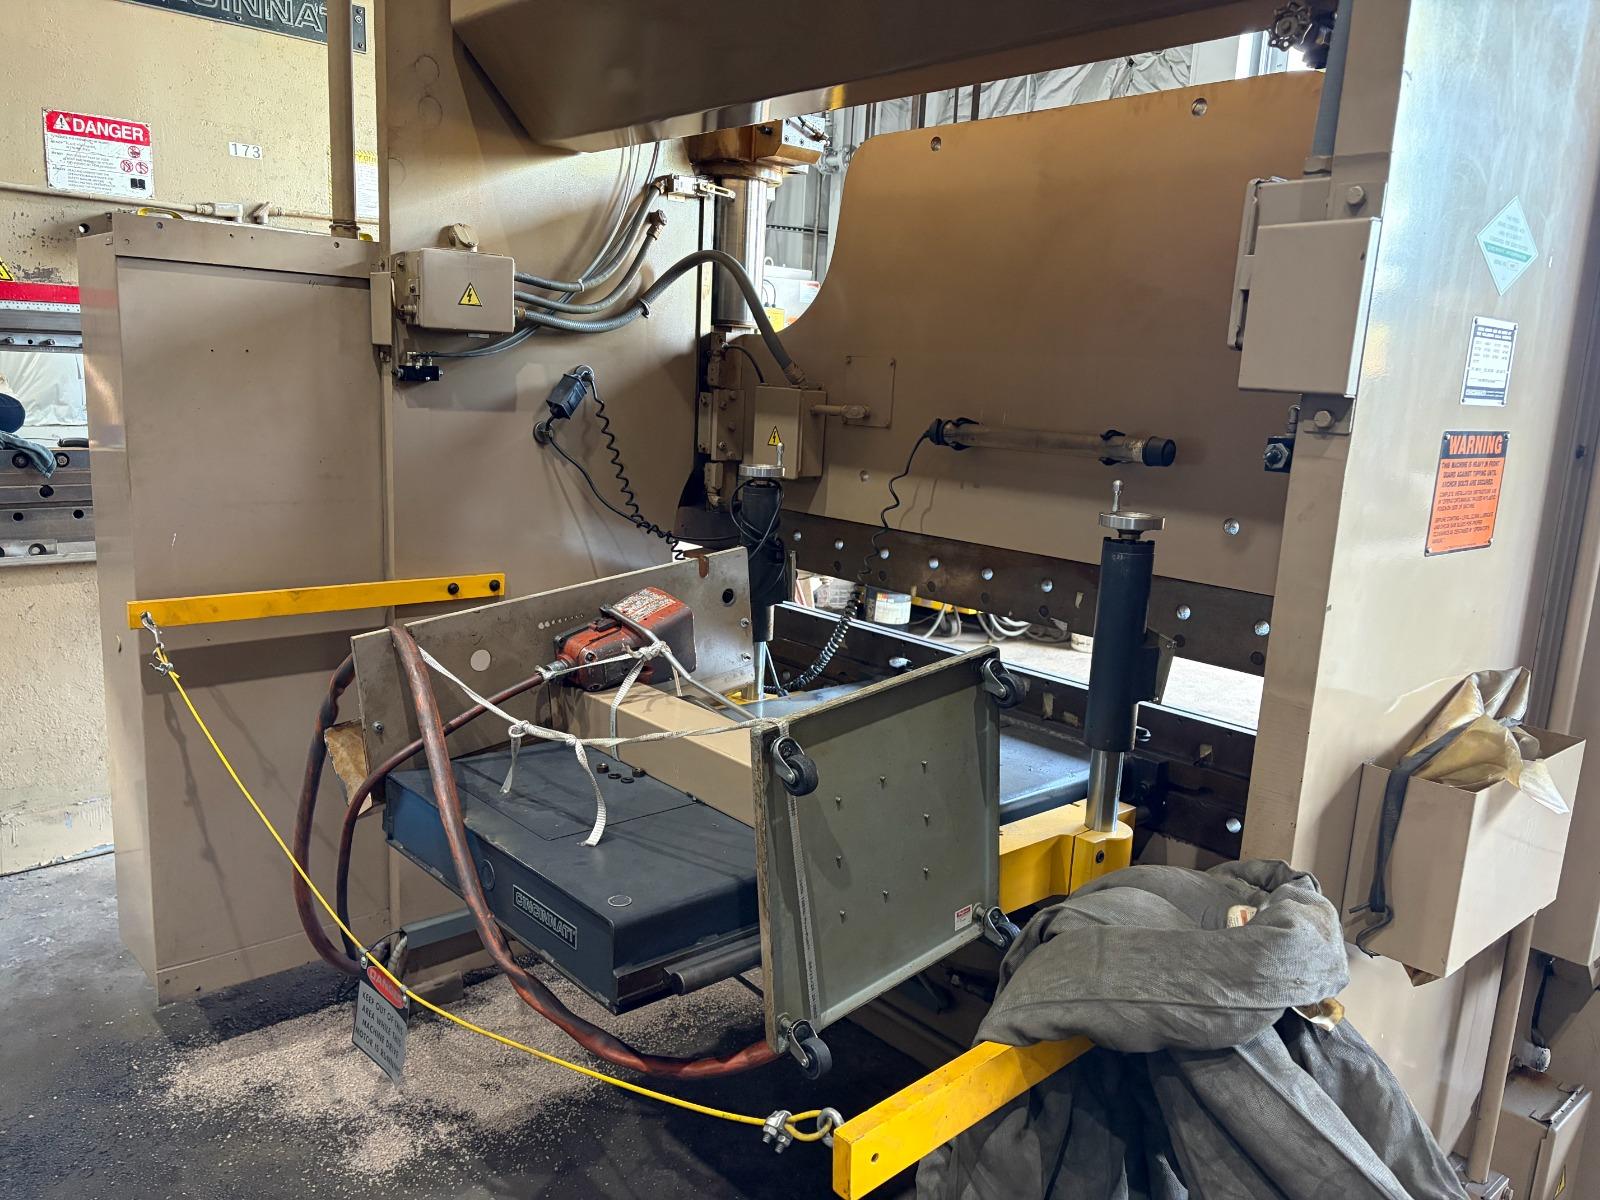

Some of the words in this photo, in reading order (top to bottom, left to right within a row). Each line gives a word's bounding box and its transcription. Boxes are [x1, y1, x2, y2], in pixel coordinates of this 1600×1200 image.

[72, 118, 145, 141] DANGER
[231, 143, 261, 159] 173
[1449, 435, 1503, 454] WARNING
[515, 891, 574, 942] CINCINNATI
[361, 1005, 375, 1021] AREA
[362, 991, 374, 1004] KEEP
[375, 1002, 386, 1015] OUT
[387, 1012, 394, 1021] OF
[355, 1026, 374, 1047] MOTOR
[361, 1019, 385, 1045] MACHINE
[385, 1038, 400, 1059] DRIVE
